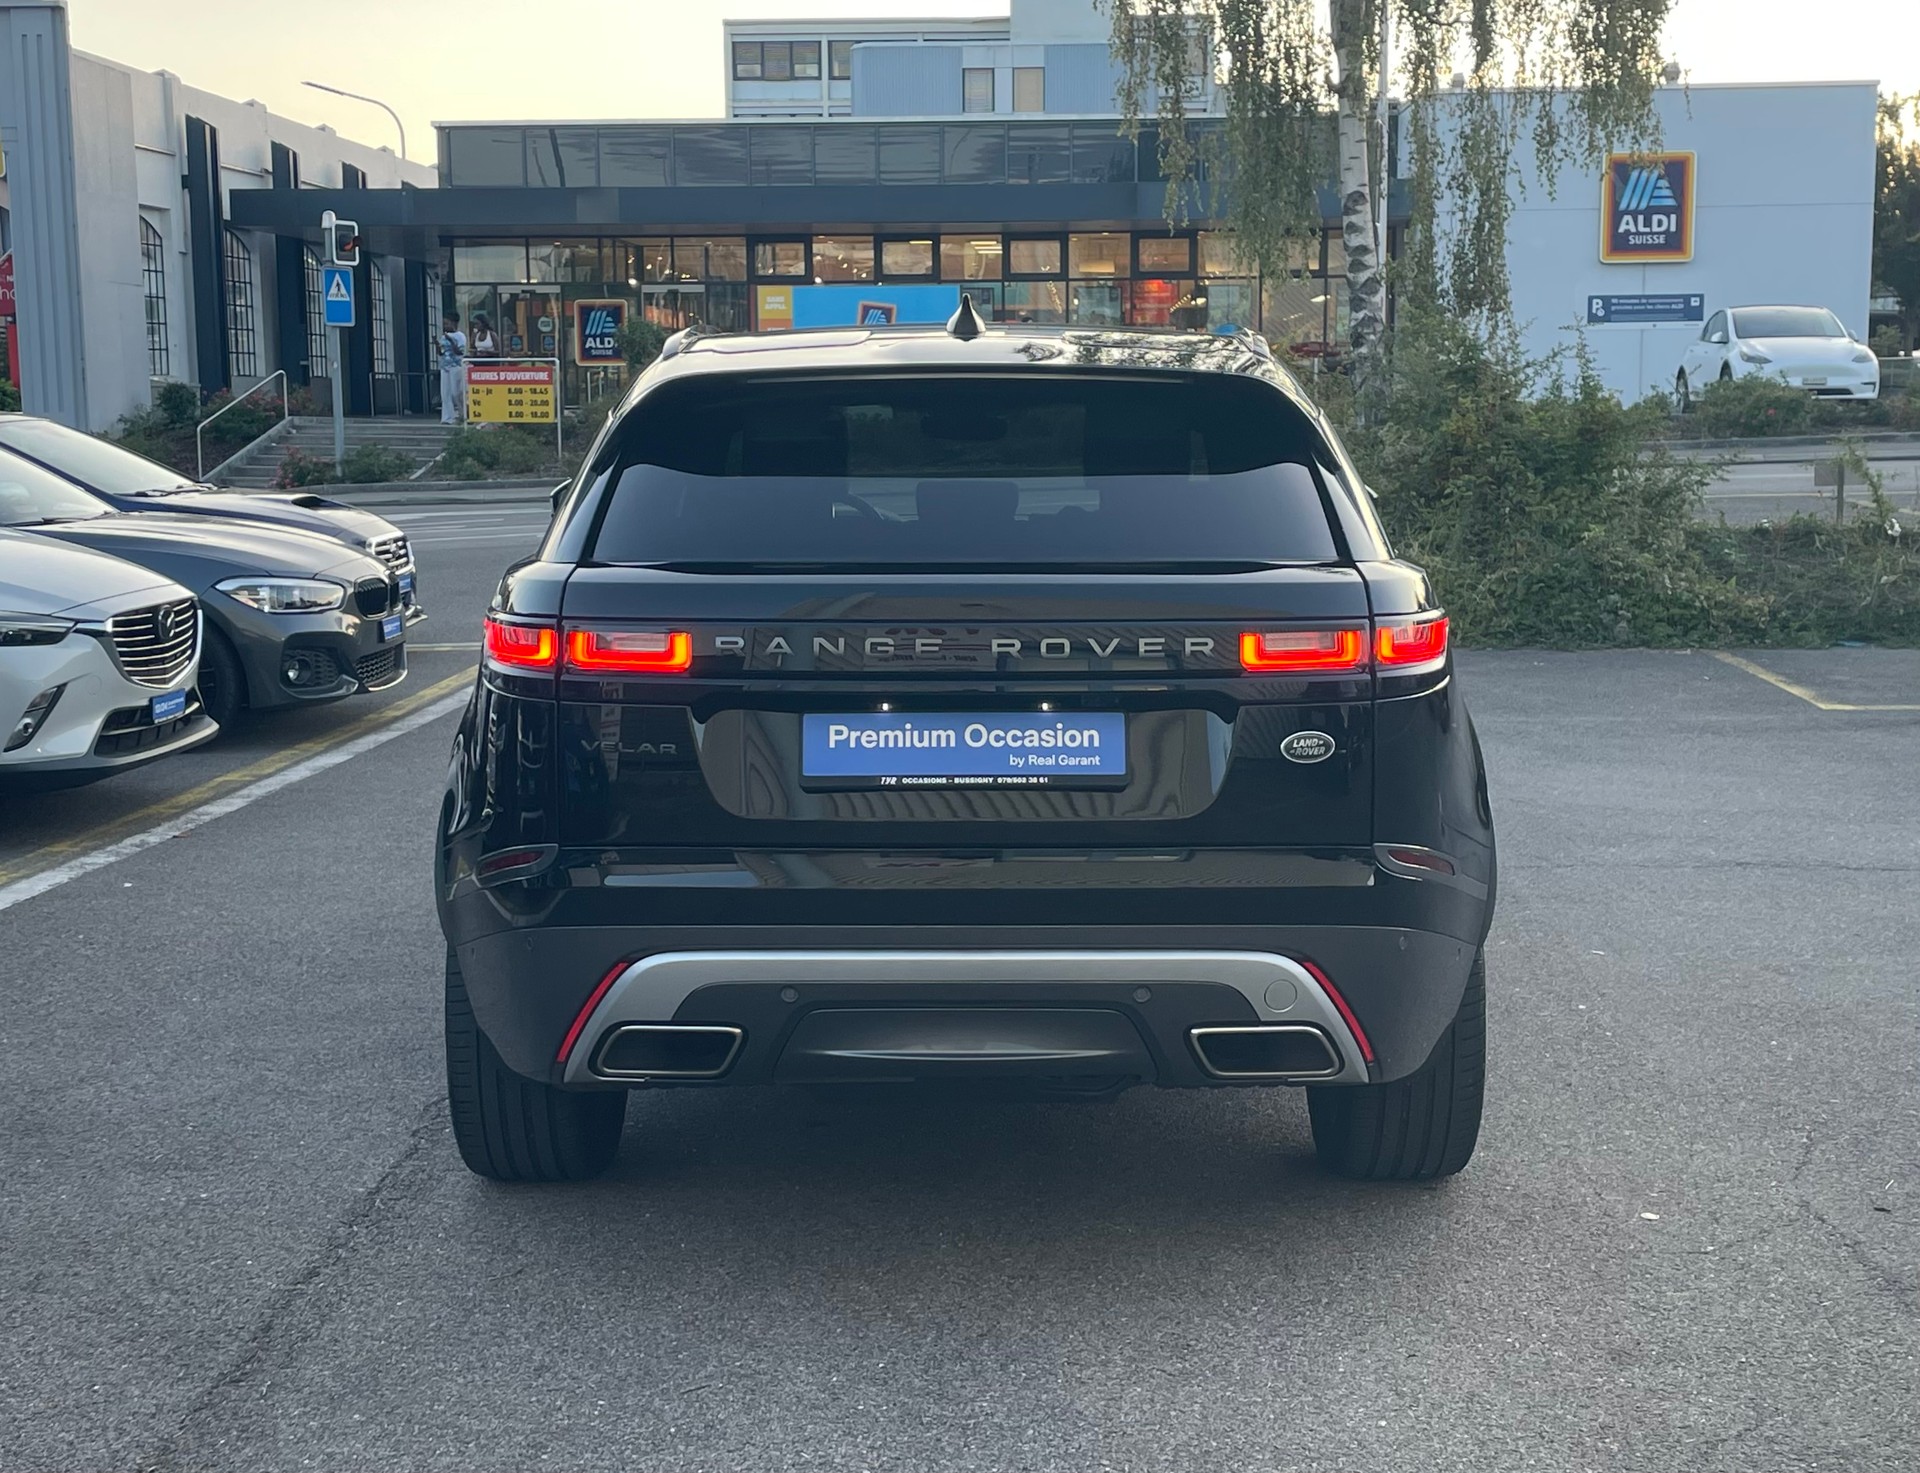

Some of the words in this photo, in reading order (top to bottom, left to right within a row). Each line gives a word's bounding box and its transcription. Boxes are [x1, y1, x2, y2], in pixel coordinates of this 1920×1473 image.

[1617, 213, 1677, 233] ALDI
[1628, 234, 1666, 245] SUISSE
[585, 337, 618, 349] ALD
[471, 371, 499, 381] HEURES
[714, 636, 944, 658] RANGE
[991, 636, 1217, 659] ROVER
[828, 723, 956, 749] Premium
[964, 723, 1100, 749] Occasion
[580, 740, 678, 754] VELAR
[1293, 738, 1318, 748] LAND
[1295, 746, 1326, 756] ROVER
[1009, 754, 1026, 767] by
[1028, 754, 1056, 767] Real
[1058, 754, 1101, 767] Garant
[901, 776, 947, 784] OCCASIONS
[954, 776, 994, 784] BUSSIGNY
